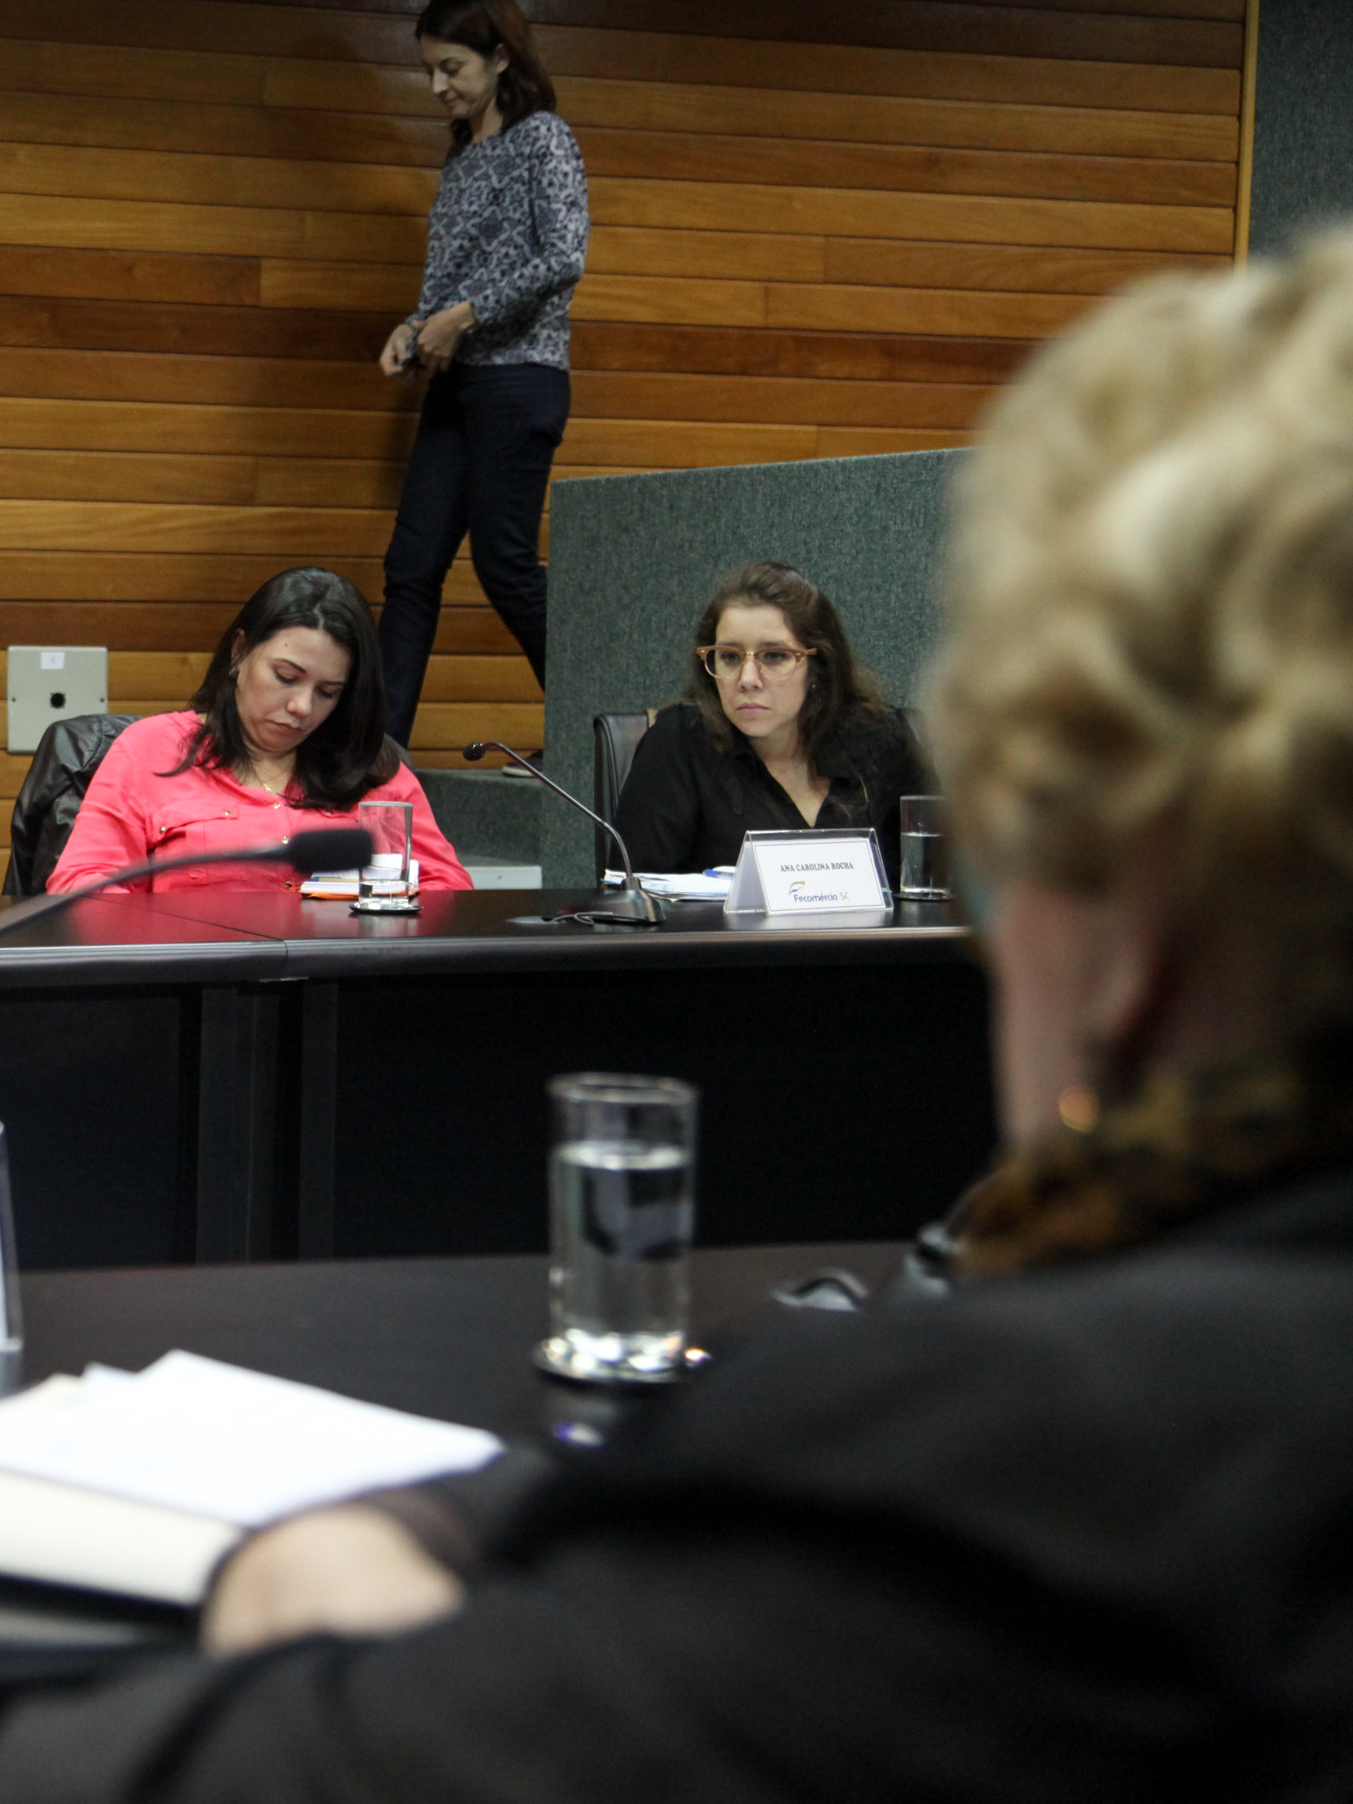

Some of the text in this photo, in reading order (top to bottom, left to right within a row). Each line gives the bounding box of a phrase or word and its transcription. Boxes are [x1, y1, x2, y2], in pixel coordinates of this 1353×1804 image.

[780, 861, 854, 872] ANA CAROLINA ROCHA
[793, 892, 838, 903] Fecomércio
